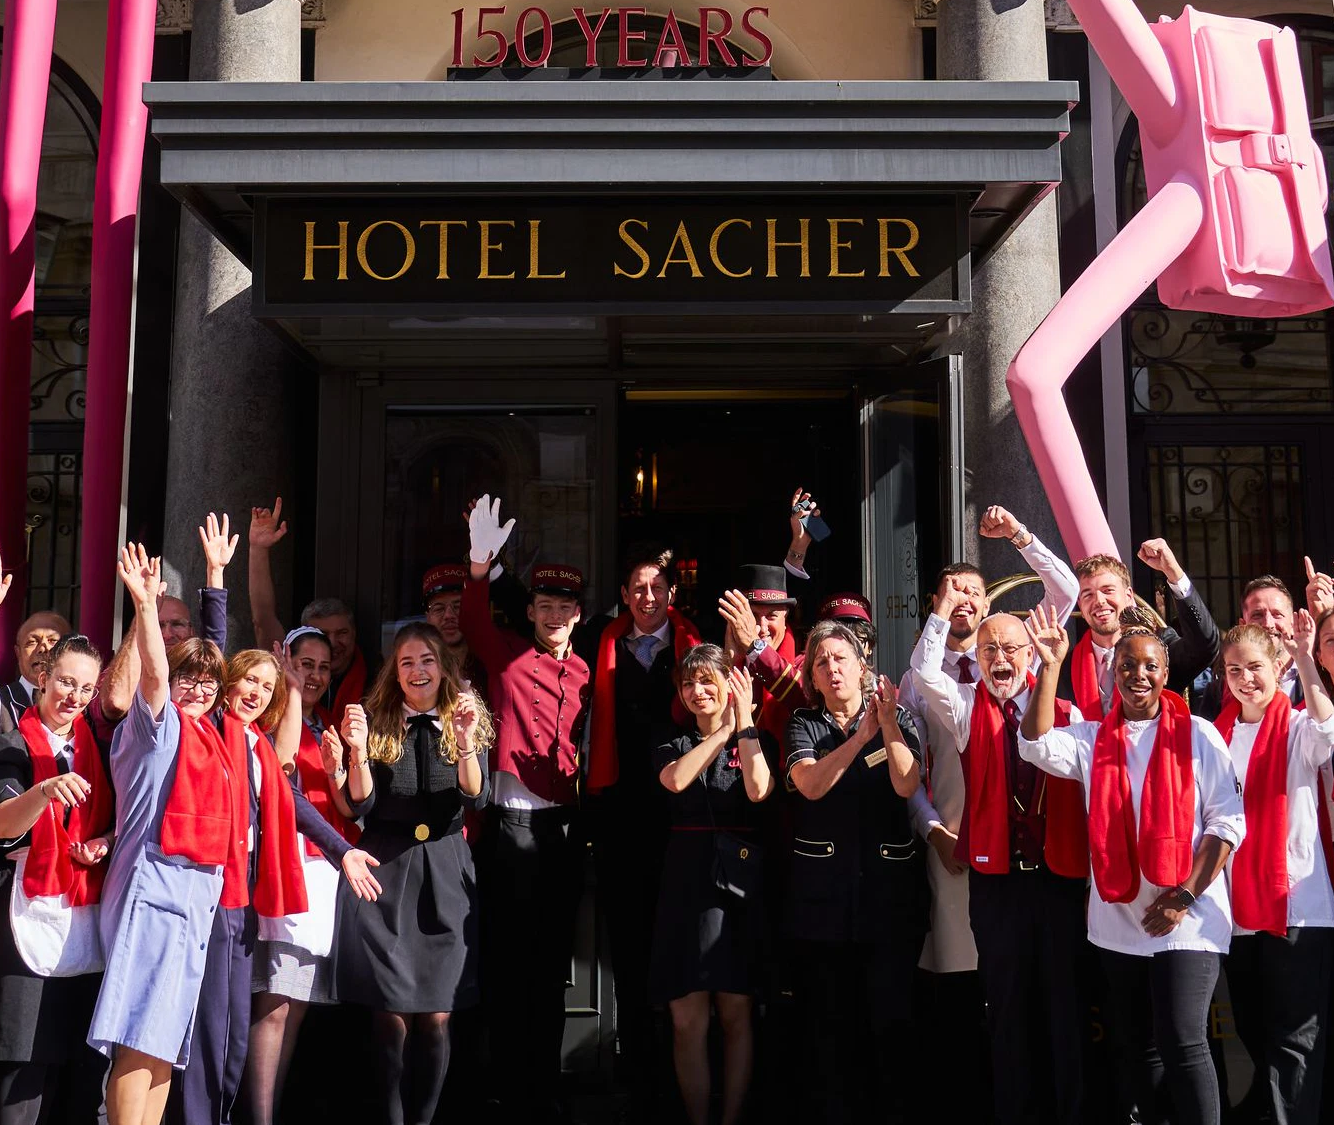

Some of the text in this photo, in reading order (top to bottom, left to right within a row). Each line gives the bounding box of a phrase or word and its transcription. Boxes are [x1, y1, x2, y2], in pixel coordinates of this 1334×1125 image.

[451, 5, 773, 68] 150 YEARS
[304, 218, 920, 281] HOTEL SACHER
